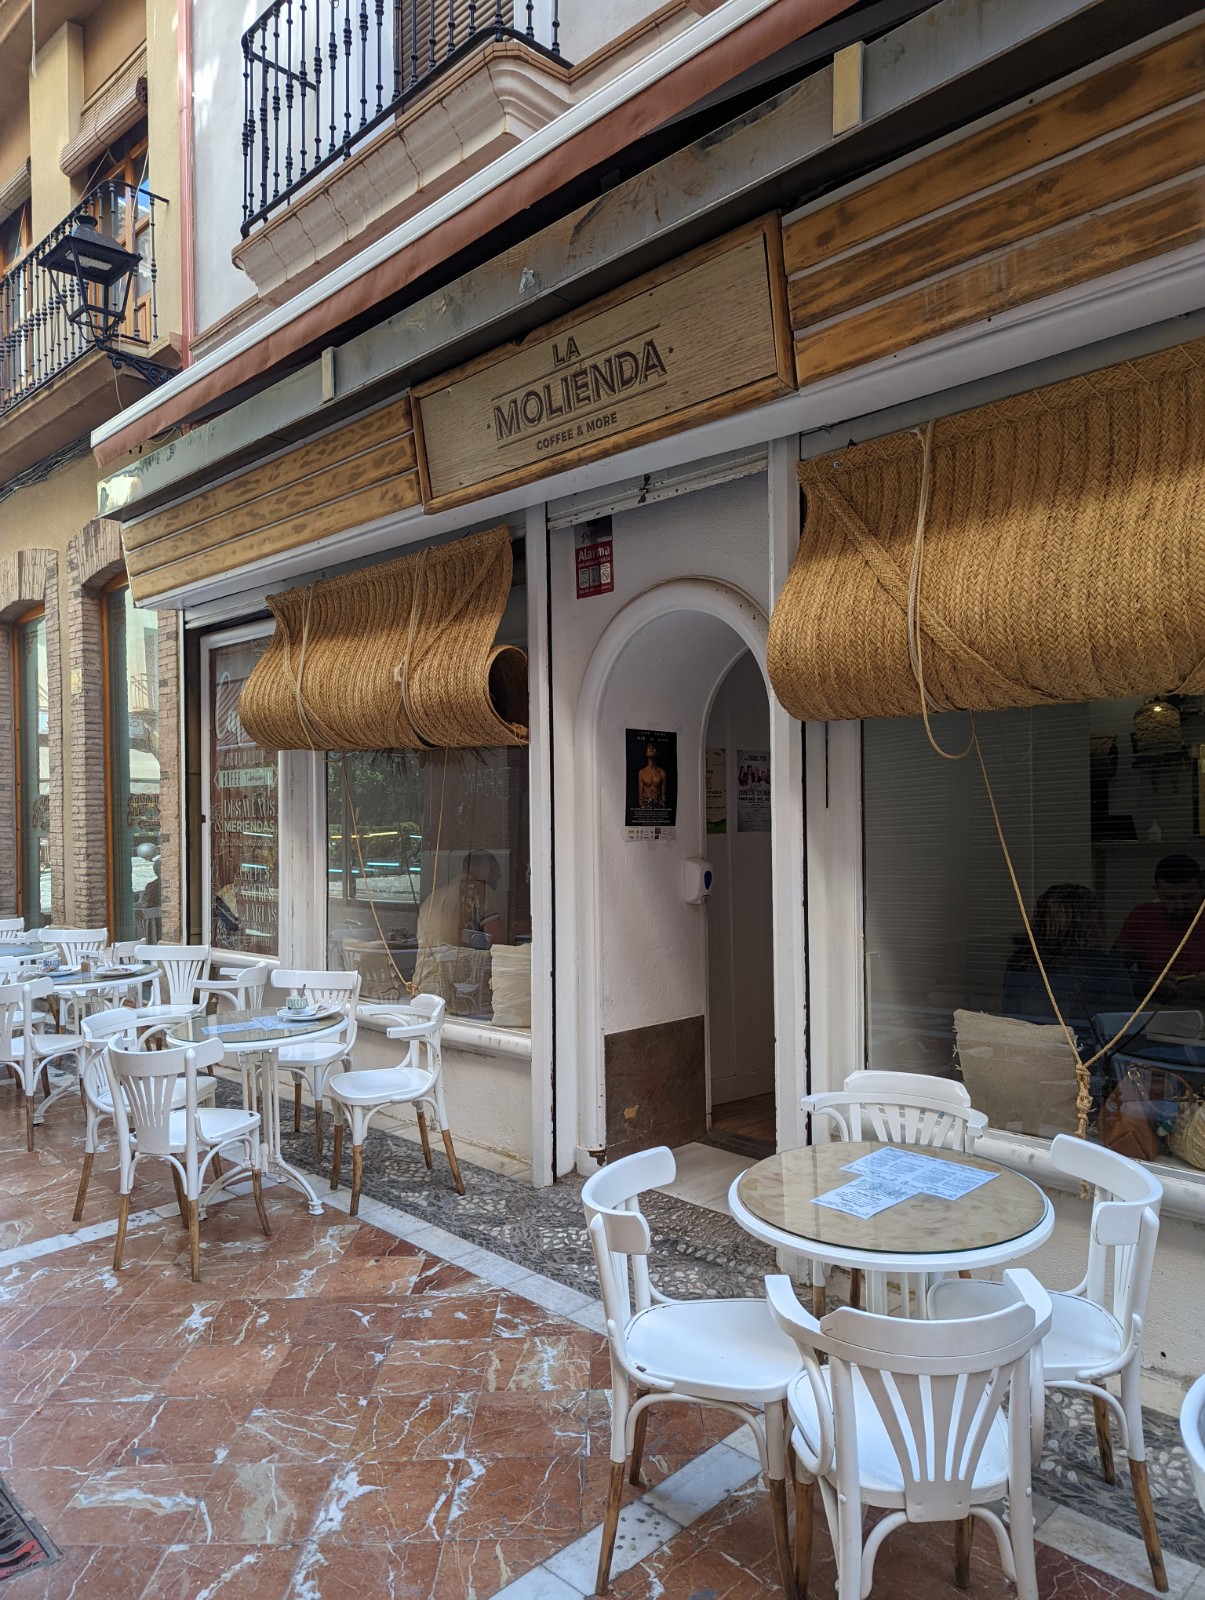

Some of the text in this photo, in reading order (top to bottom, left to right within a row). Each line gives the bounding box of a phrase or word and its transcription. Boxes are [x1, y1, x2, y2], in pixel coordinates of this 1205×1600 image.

[552, 336, 581, 367] LA
[493, 338, 668, 441] MOLIENDA
[536, 411, 618, 450] COFFEE & MORE
[578, 546, 610, 562] Alarma
[224, 820, 275, 833] MERIENDAS
